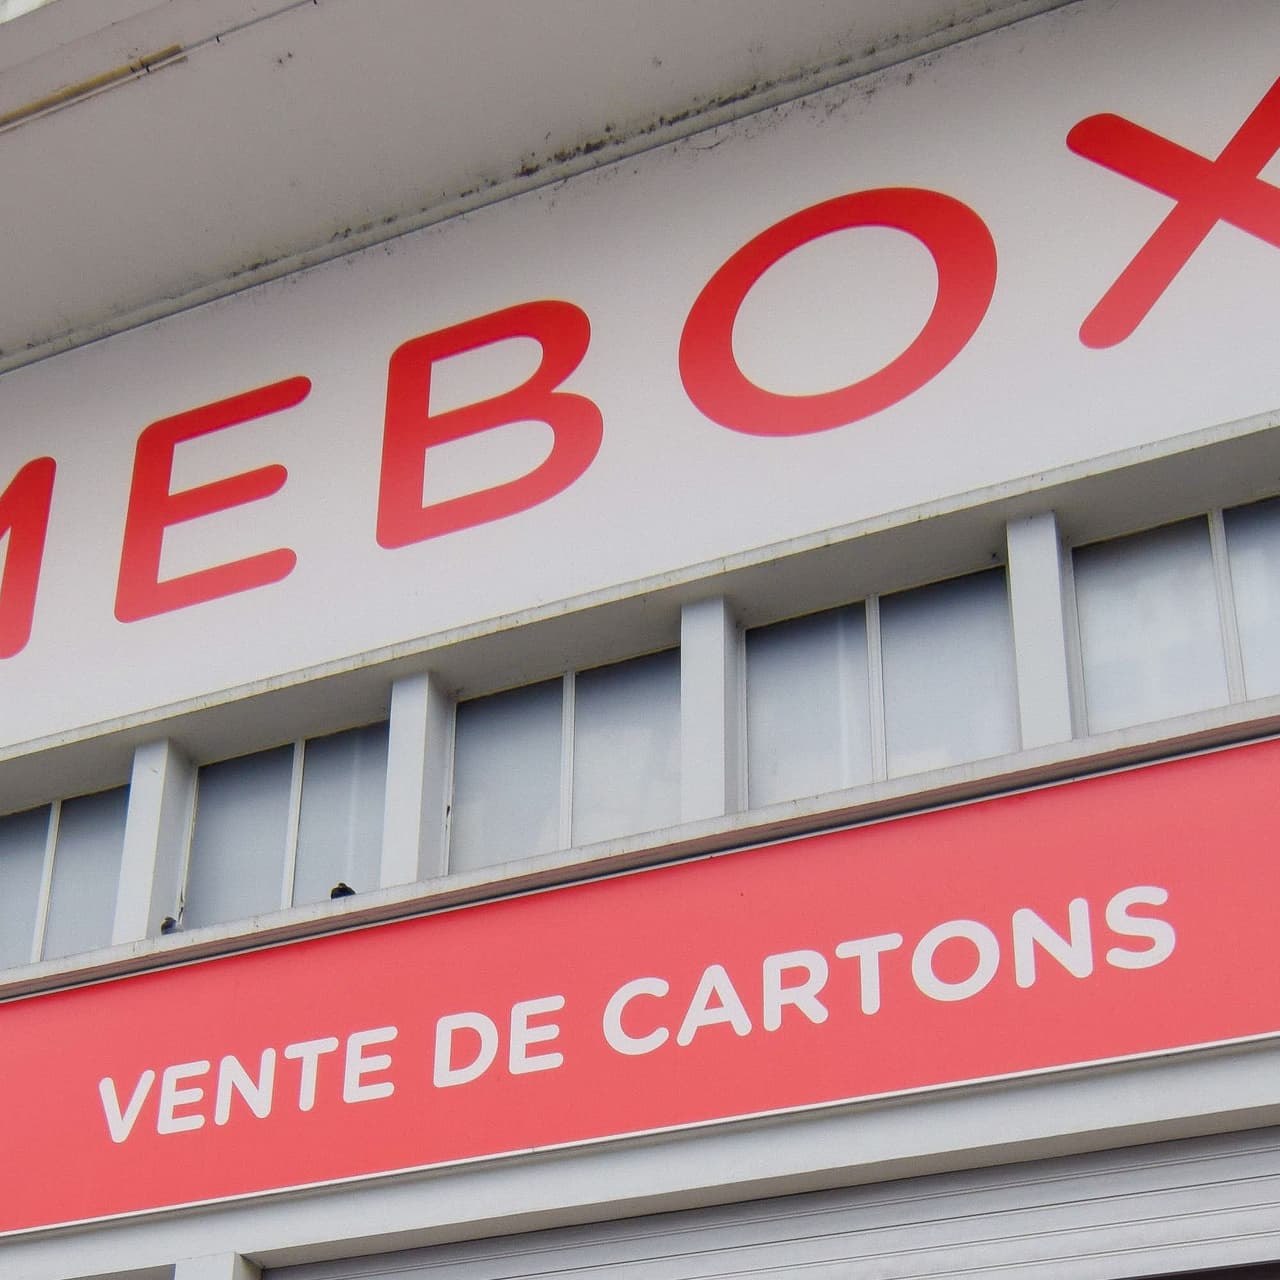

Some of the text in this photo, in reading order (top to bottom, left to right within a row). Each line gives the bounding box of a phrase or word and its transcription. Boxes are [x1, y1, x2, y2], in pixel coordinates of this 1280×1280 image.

[98, 884, 1177, 1144] VENTE DE CARTONS
